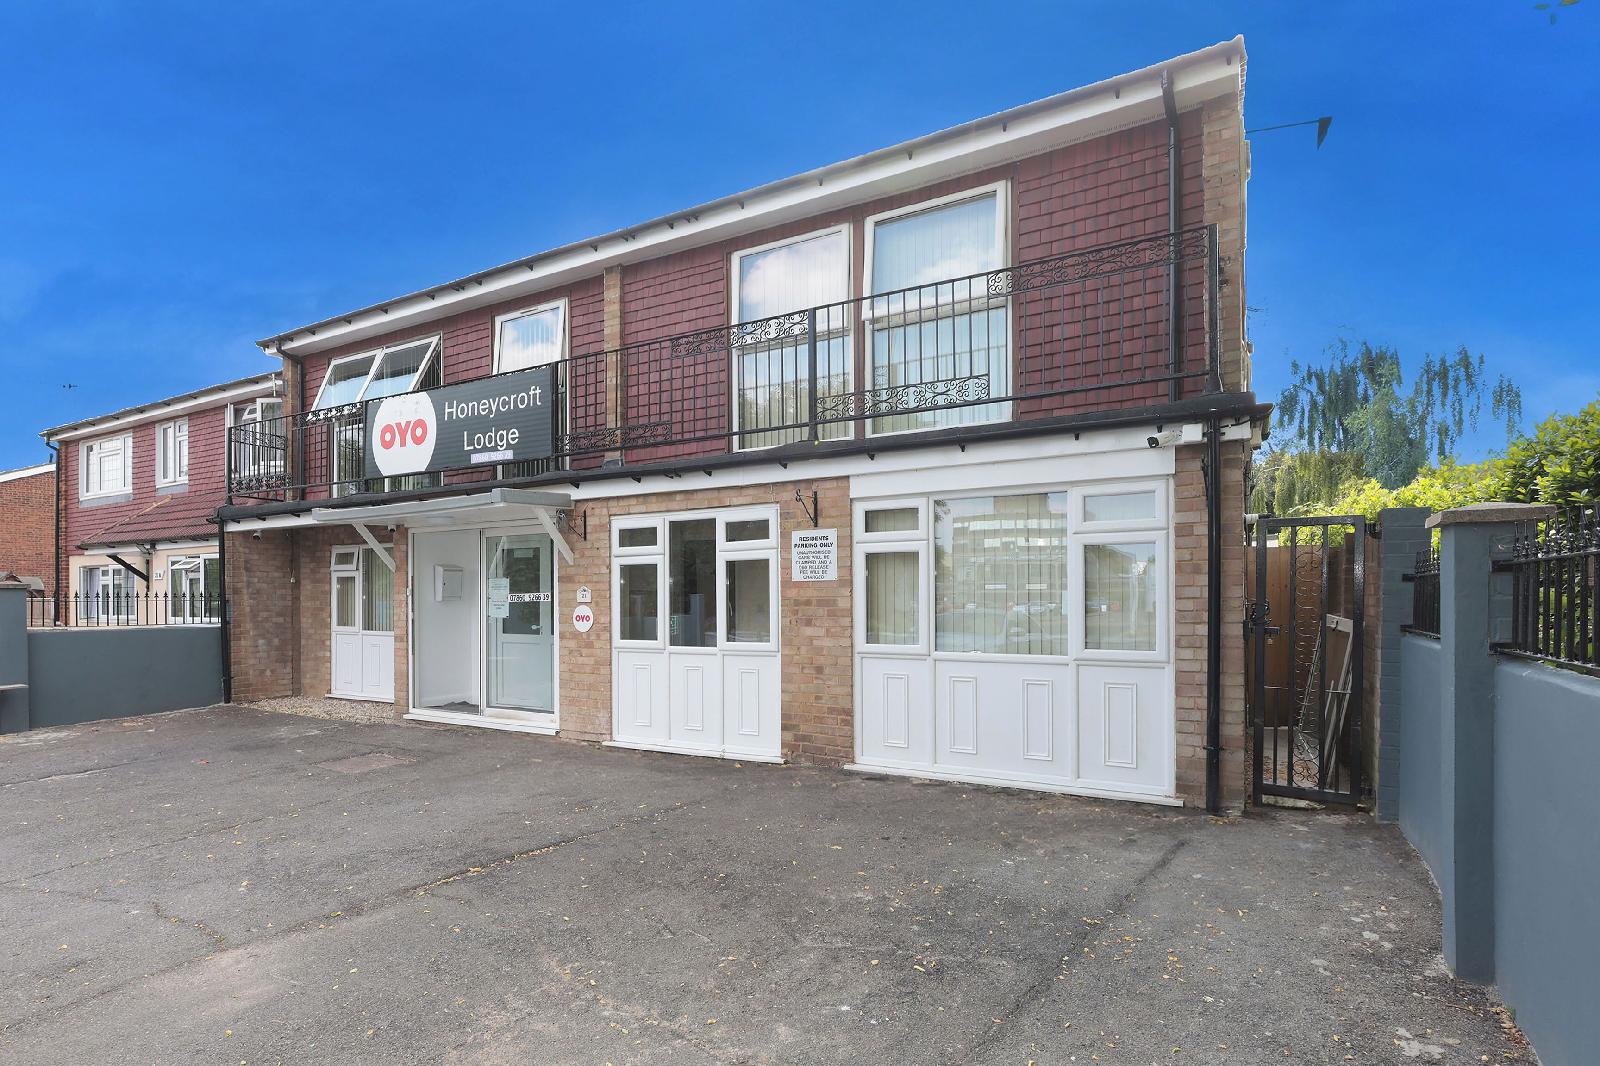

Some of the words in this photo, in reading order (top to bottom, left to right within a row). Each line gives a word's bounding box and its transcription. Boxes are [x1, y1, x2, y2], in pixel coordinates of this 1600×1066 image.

[444, 385, 542, 420] Honeycroft
[380, 418, 428, 450] OYO
[463, 427, 520, 450] Lodge
